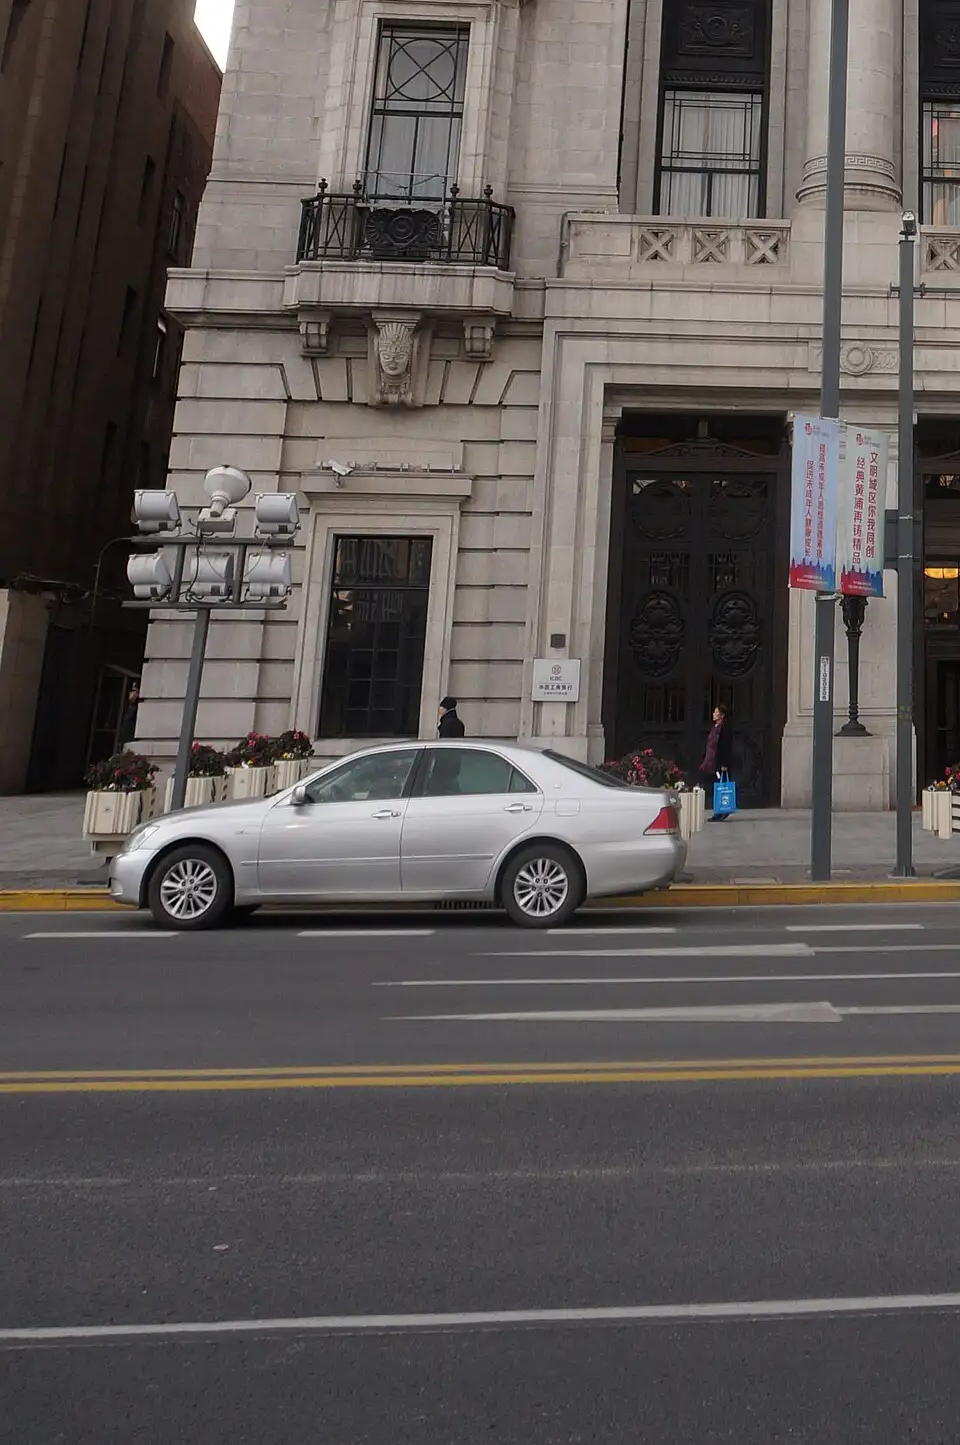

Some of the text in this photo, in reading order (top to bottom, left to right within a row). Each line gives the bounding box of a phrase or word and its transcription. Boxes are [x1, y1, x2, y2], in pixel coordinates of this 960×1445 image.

[852, 457, 865, 564] 经典黄浦再铸精品
[866, 452, 878, 558] 文明城区你我同创
